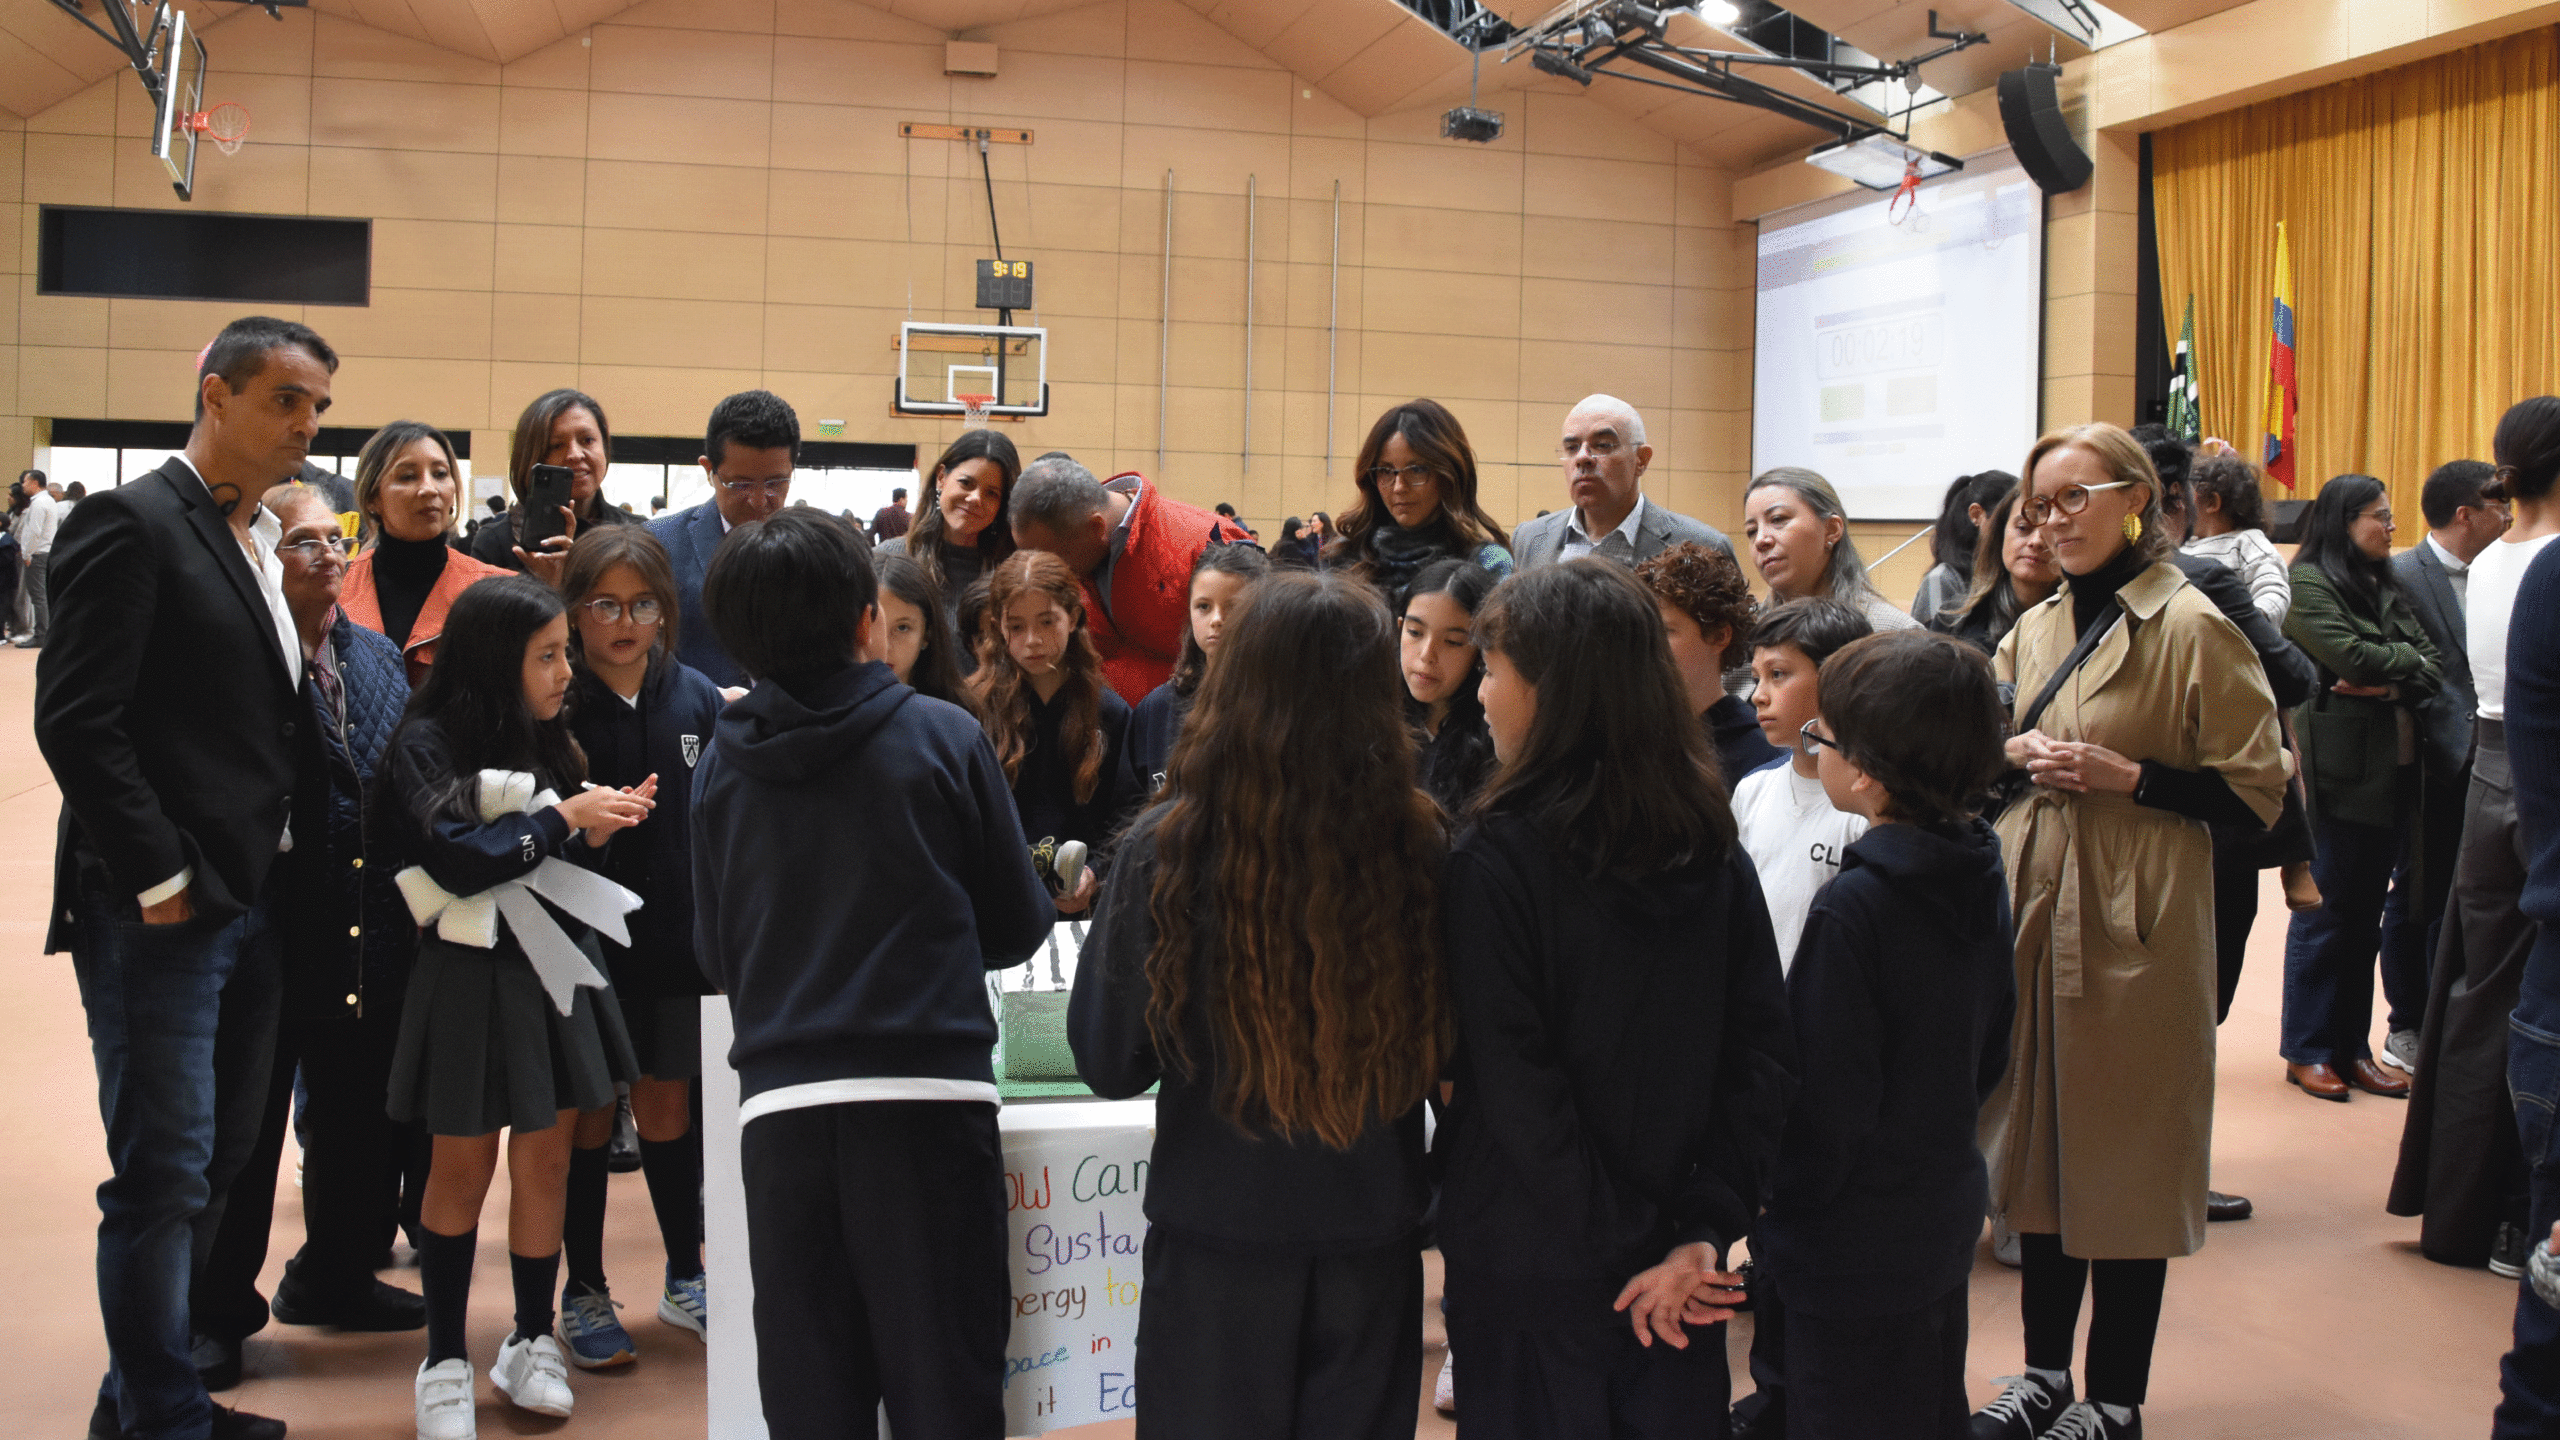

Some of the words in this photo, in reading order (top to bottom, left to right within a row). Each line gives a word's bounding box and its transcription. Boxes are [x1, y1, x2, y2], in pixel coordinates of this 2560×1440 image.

[993, 260, 1027, 278] 9:19
[1831, 322, 1924, 367] 00:02:19
[520, 834, 535, 862] CLN
[1810, 843, 1840, 867] CL
[1073, 1155, 1150, 1202] Can
[1025, 1211, 1152, 1275] Susta
[1104, 1267, 1139, 1307] to
[1091, 1333, 1112, 1355] in
[1038, 1385, 1057, 1417] it
